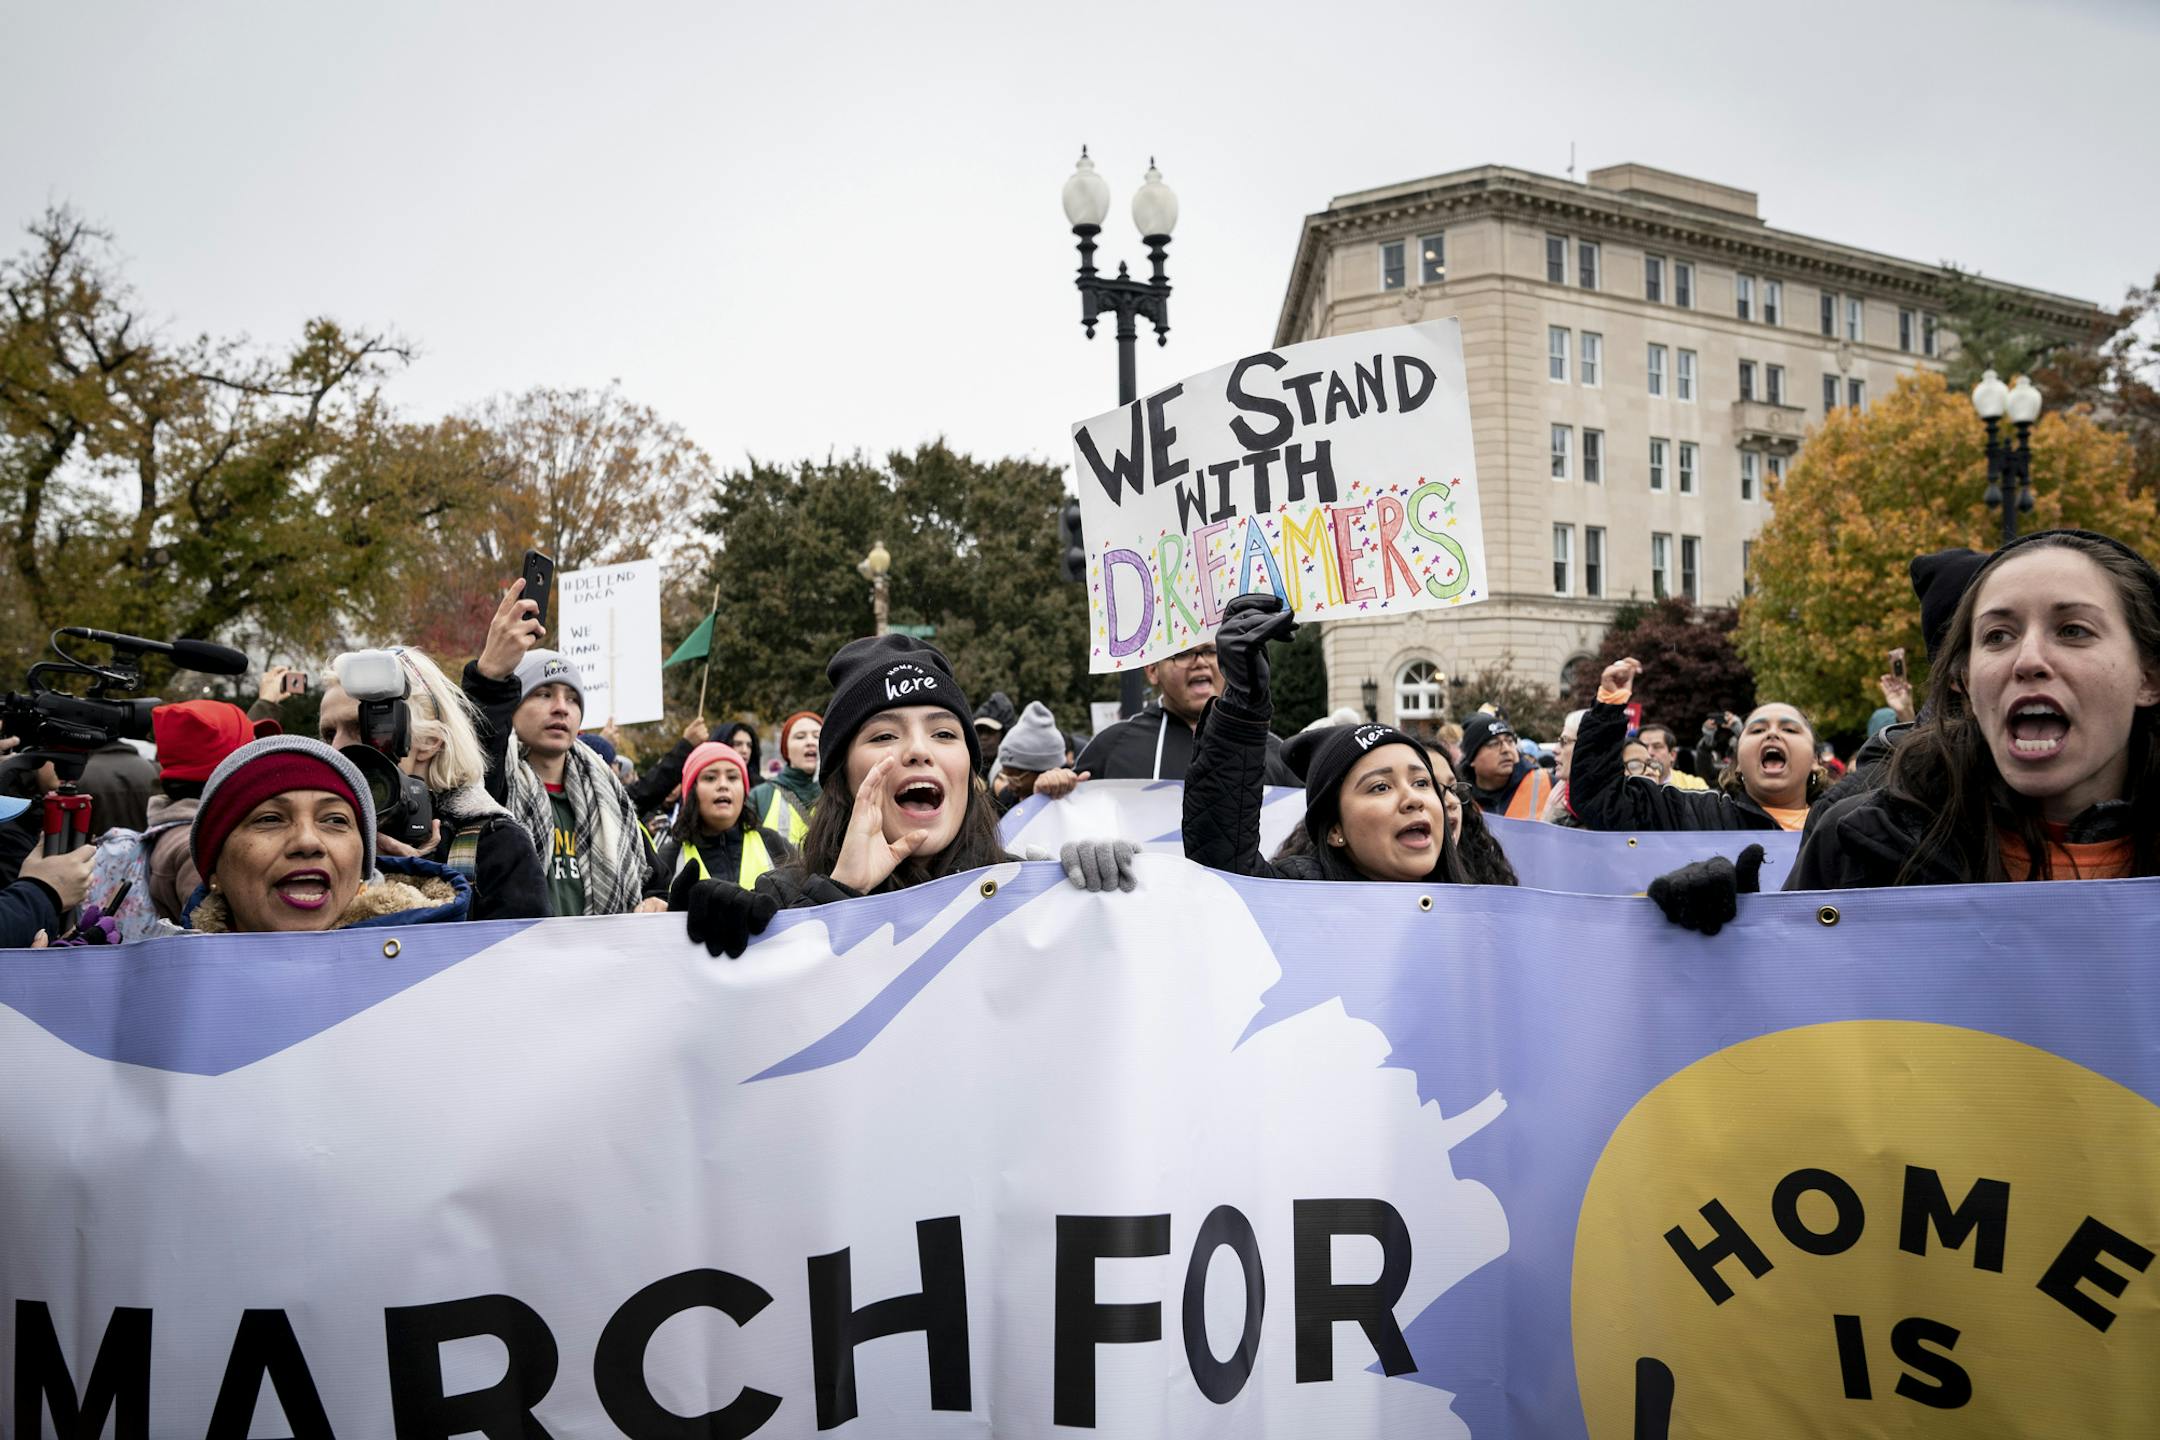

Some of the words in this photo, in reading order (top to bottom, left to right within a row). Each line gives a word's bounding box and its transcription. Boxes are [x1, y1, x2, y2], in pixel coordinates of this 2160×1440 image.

[1074, 382, 1189, 507] WE
[1226, 351, 1438, 451] STAND
[1175, 439, 1338, 536] WITH
[574, 588, 614, 604] DACA
[1103, 481, 1470, 658] DREAMERS
[544, 665, 569, 678] here
[561, 643, 601, 657] STAND
[571, 625, 592, 639] WE
[885, 676, 938, 701] here
[1663, 1164, 2157, 1334] HOME
[13, 1215, 972, 1440] MARCH
[1053, 1197, 1419, 1429] FOR
[1833, 1313, 1973, 1409] IS
